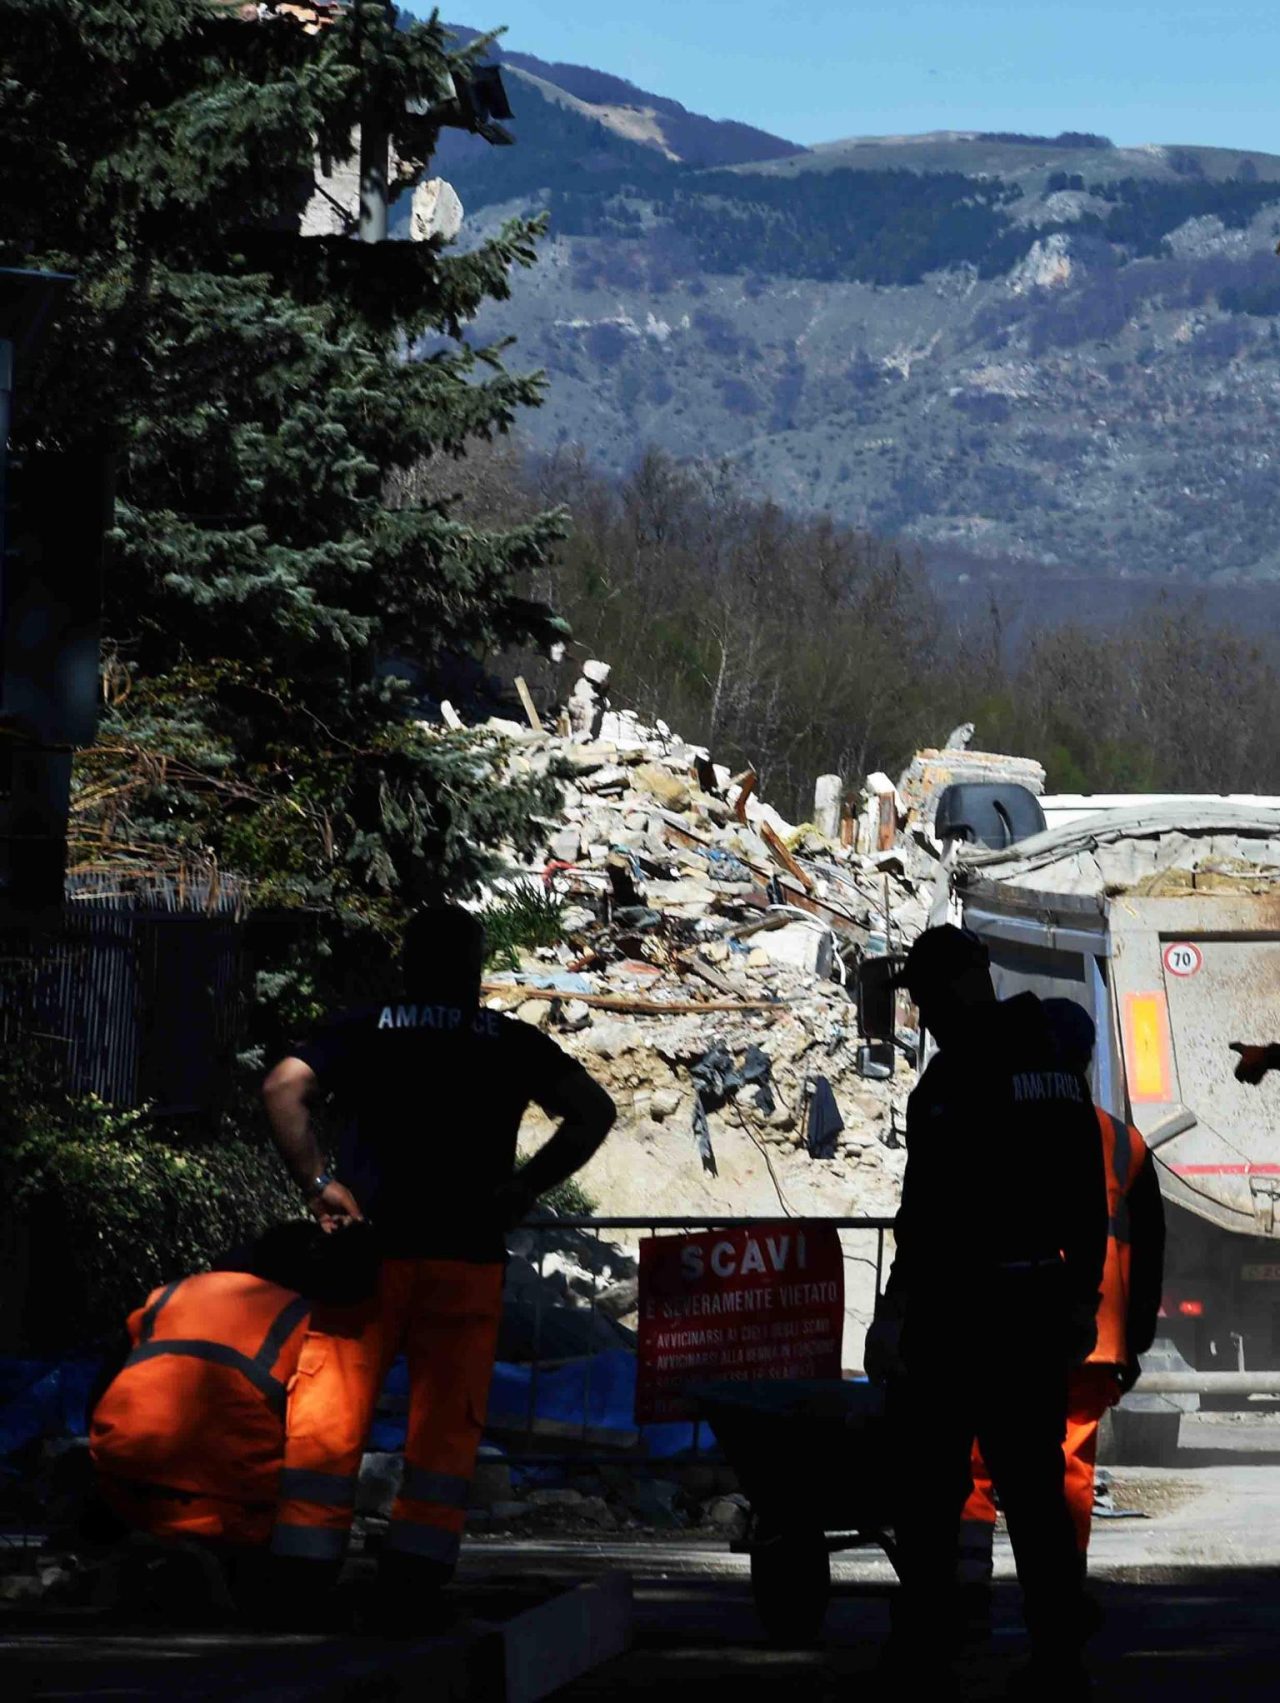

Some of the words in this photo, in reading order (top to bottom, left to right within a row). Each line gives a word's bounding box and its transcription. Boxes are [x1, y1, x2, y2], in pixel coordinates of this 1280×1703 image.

[1173, 952, 1191, 967] 70
[377, 1005, 500, 1035] AMATRCE
[680, 1231, 808, 1280] SCAVI
[663, 1288, 774, 1318] SEVERAMENTE
[779, 1281, 839, 1309] VIETATO
[657, 1330, 723, 1349] AVVICINARSI
